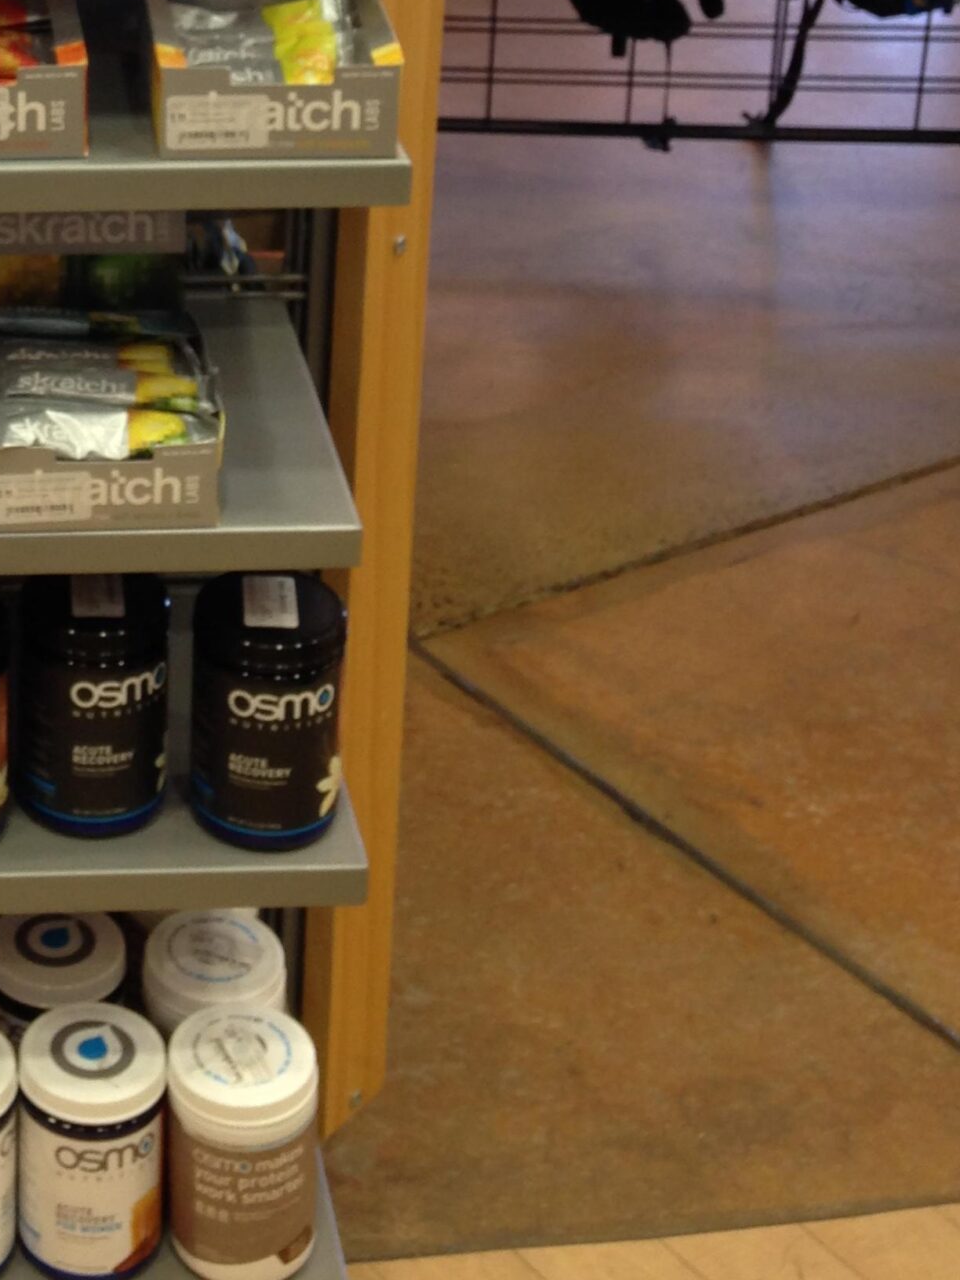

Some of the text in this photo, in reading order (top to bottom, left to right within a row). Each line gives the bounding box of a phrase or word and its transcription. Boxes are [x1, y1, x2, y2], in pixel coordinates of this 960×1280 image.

[70, 662, 167, 708] osmo
[228, 683, 336, 722] osmo
[55, 1132, 154, 1173] osmo
